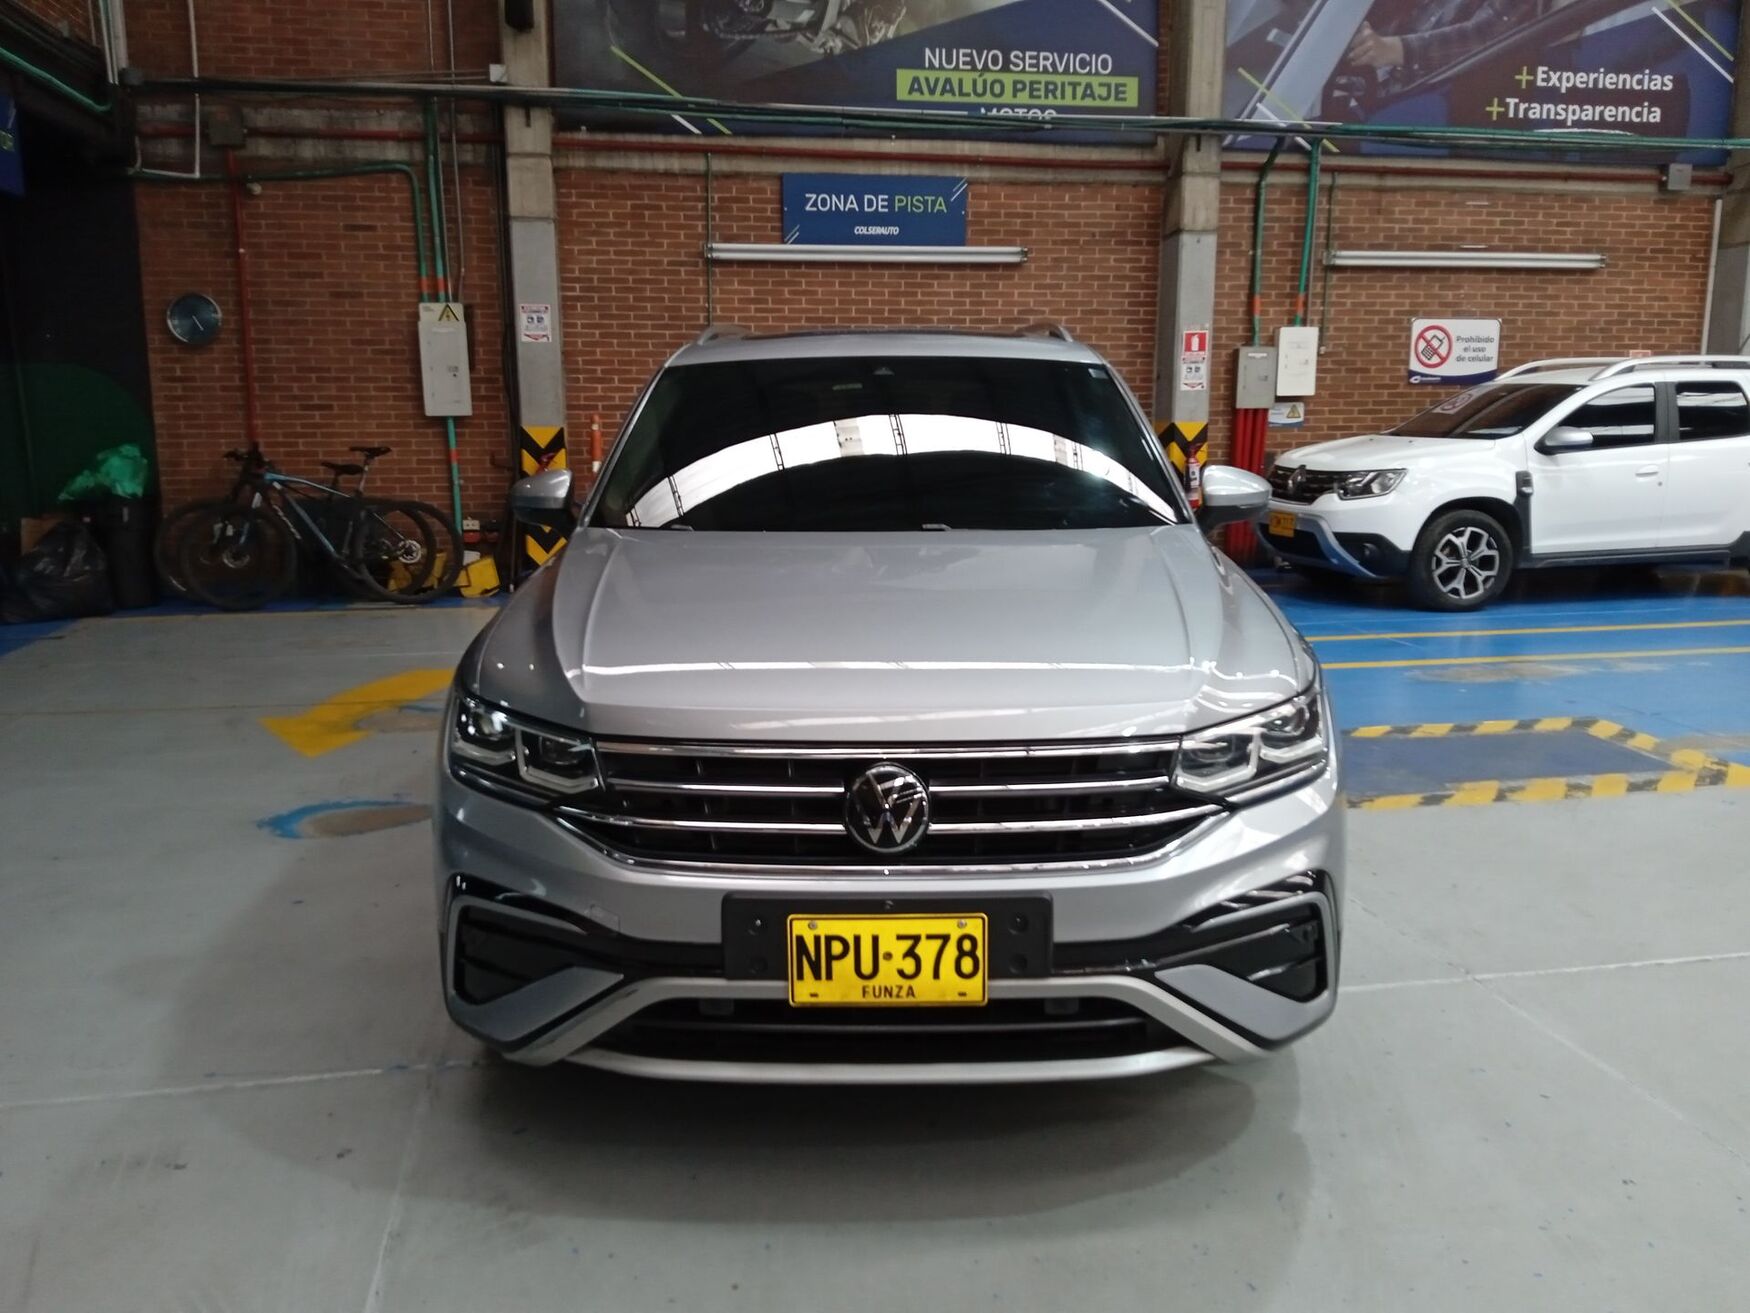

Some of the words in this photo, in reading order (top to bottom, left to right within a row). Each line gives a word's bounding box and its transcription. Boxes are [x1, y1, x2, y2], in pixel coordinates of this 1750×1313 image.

[924, 47, 1004, 71] NUEVO
[1009, 50, 1113, 74] SERVICIO
[908, 71, 1006, 98] AVALÚO
[1012, 79, 1128, 102] PERITAJE
[805, 193, 859, 212] ZONA
[864, 195, 889, 213] DE
[895, 195, 948, 214] PISTA
[854, 226, 900, 236] COLSERAUTO
[862, 985, 916, 999] FUNZA
